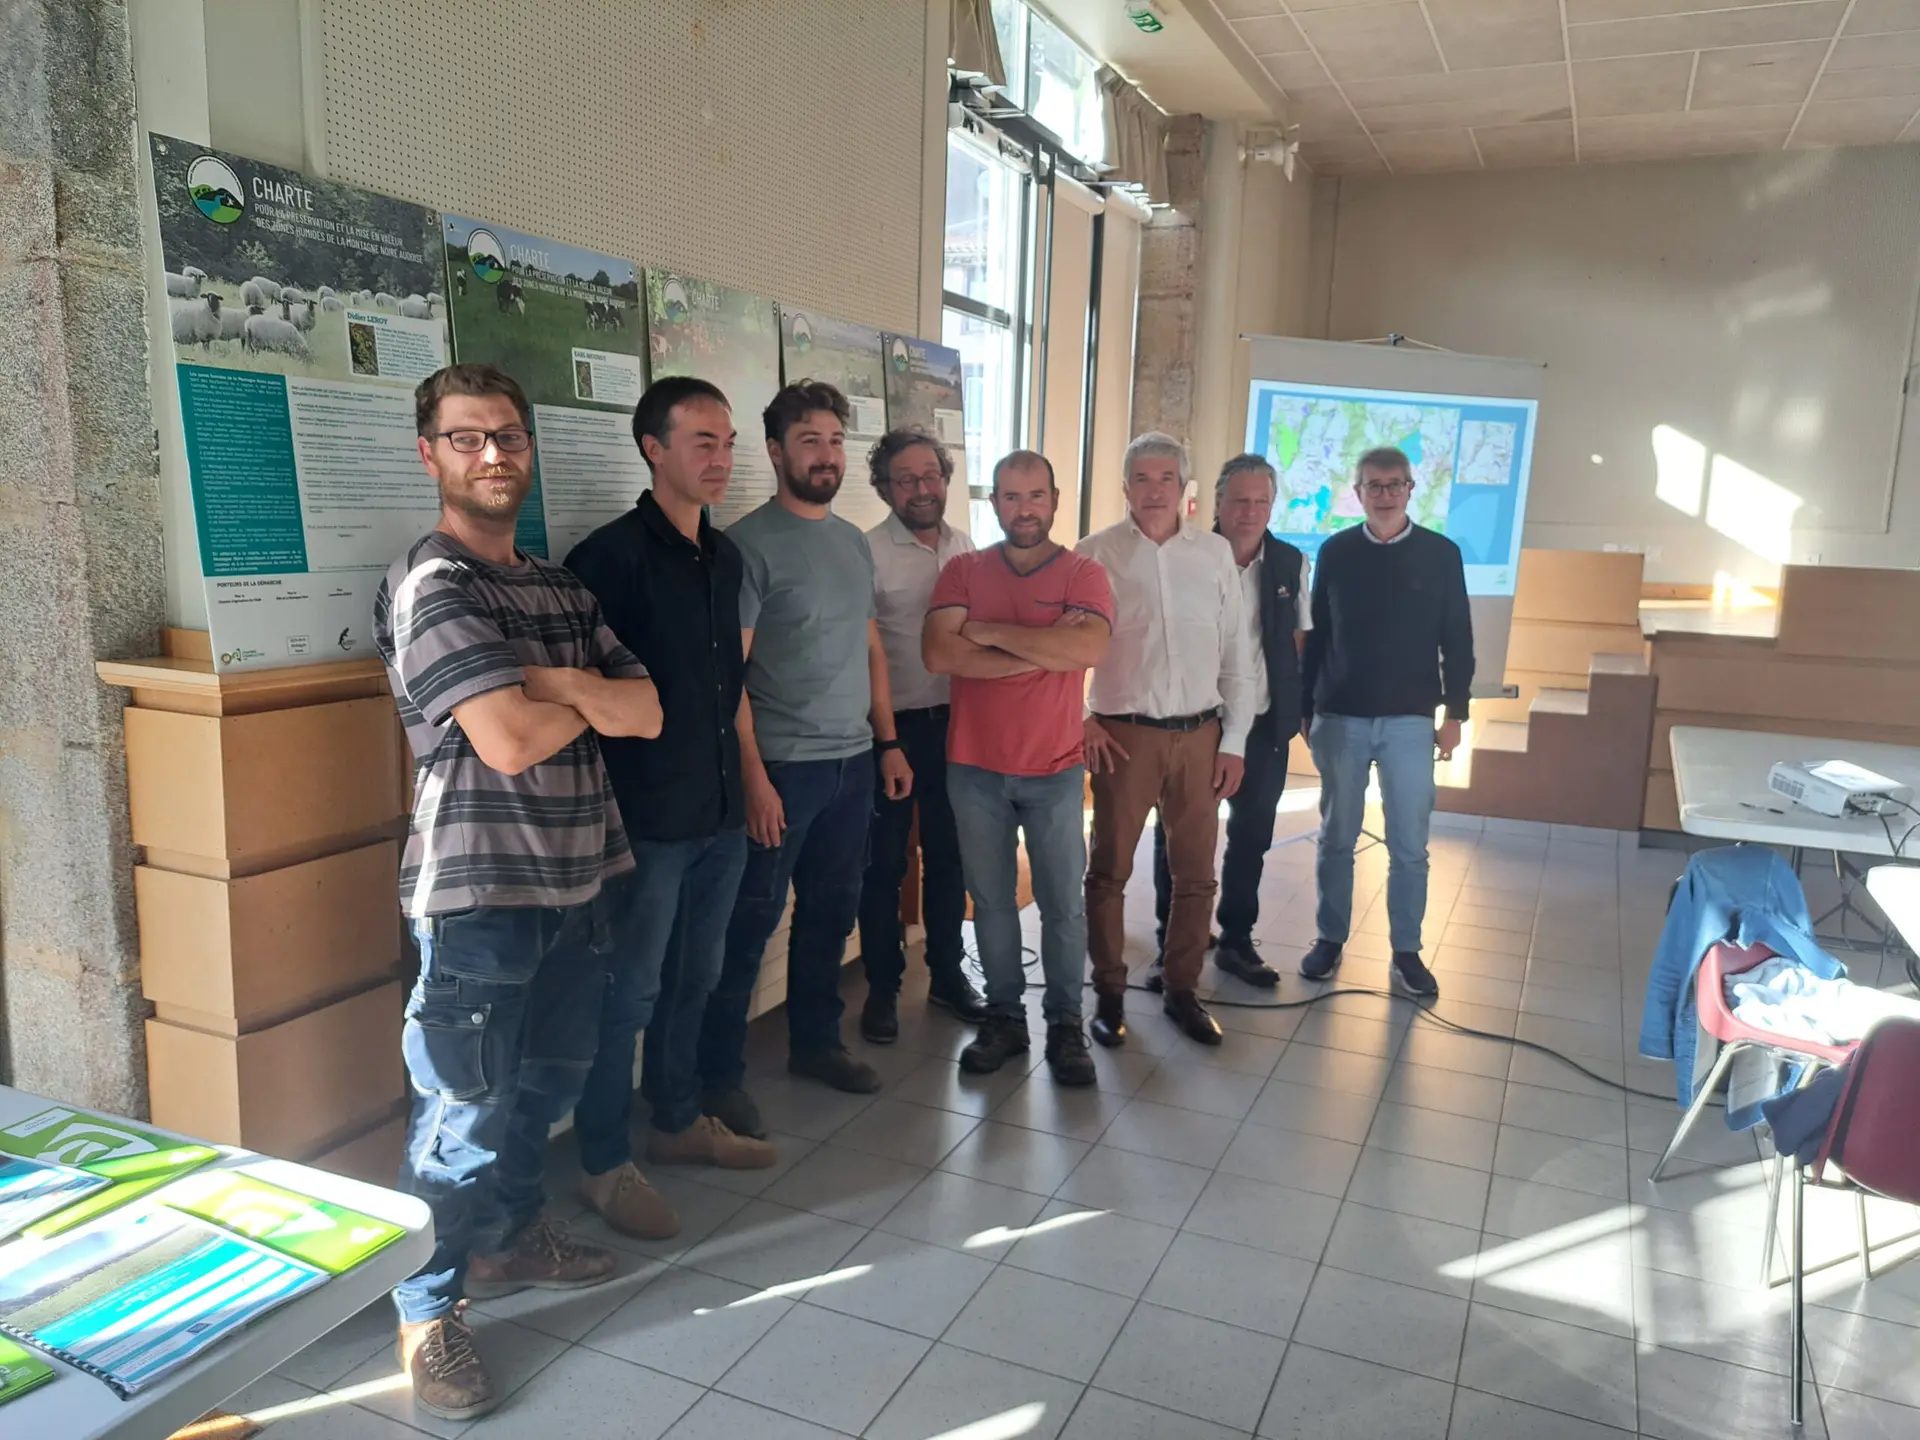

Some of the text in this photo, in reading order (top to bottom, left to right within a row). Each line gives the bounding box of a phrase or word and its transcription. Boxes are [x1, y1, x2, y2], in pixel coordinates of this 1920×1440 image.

[253, 176, 314, 211] CHARTE
[254, 203, 275, 216] POUR
[510, 244, 551, 270] CHARTE
